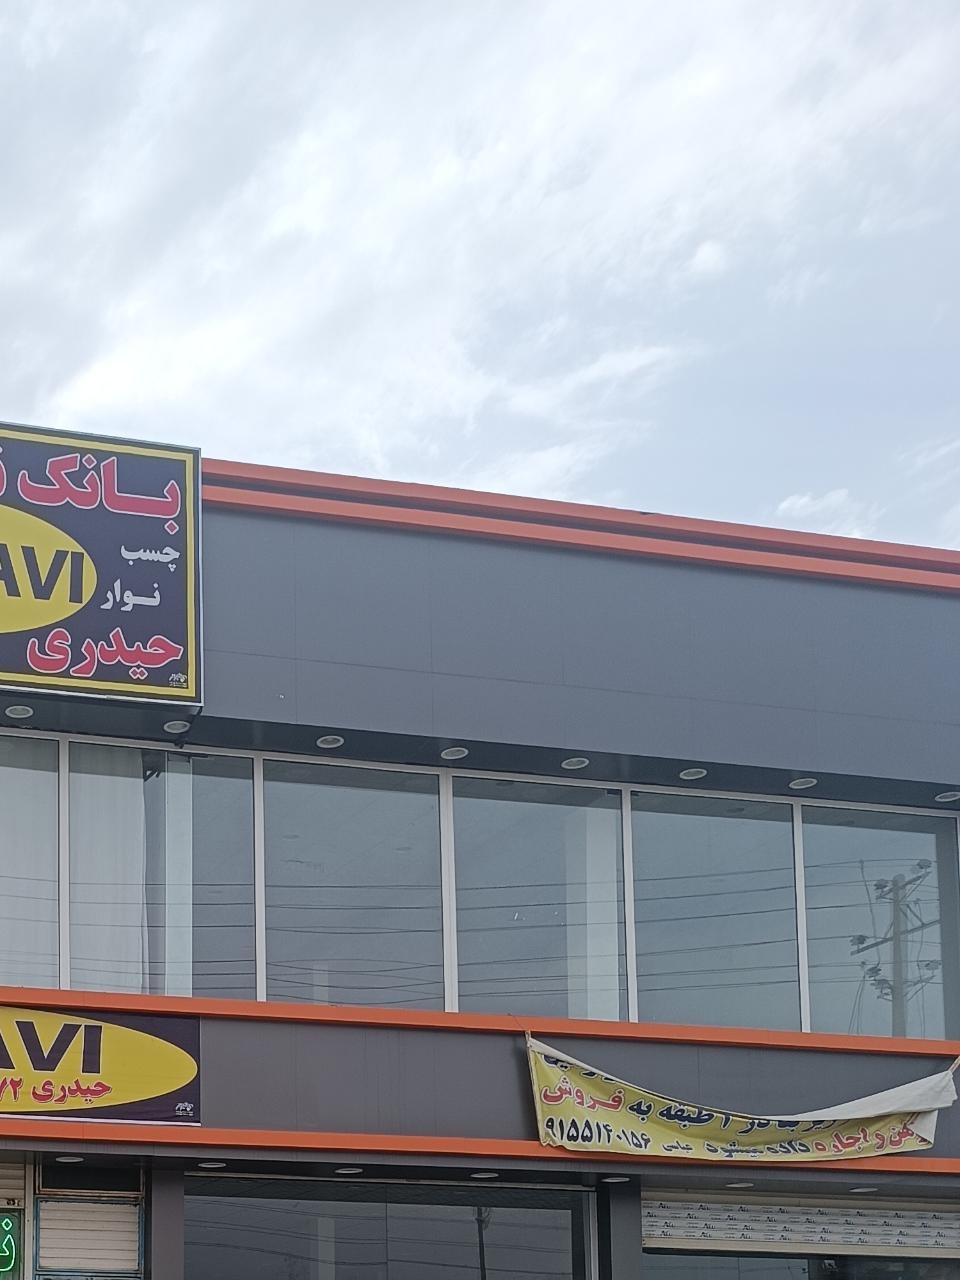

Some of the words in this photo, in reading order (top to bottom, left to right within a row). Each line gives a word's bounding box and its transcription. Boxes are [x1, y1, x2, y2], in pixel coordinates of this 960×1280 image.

[18, 453, 182, 535] بانک
[120, 545, 181, 573] چسب
[100, 578, 161, 612] نوار
[26, 627, 185, 680] حیدری
[31, 1078, 113, 1105] حیدری
[541, 1075, 625, 1113] فروش
[626, 1098, 655, 1124] به
[657, 1103, 716, 1130] طبقه
[766, 1139, 811, 1154] داده
[813, 1126, 869, 1154] اجاره
[874, 1131, 886, 1151] و
